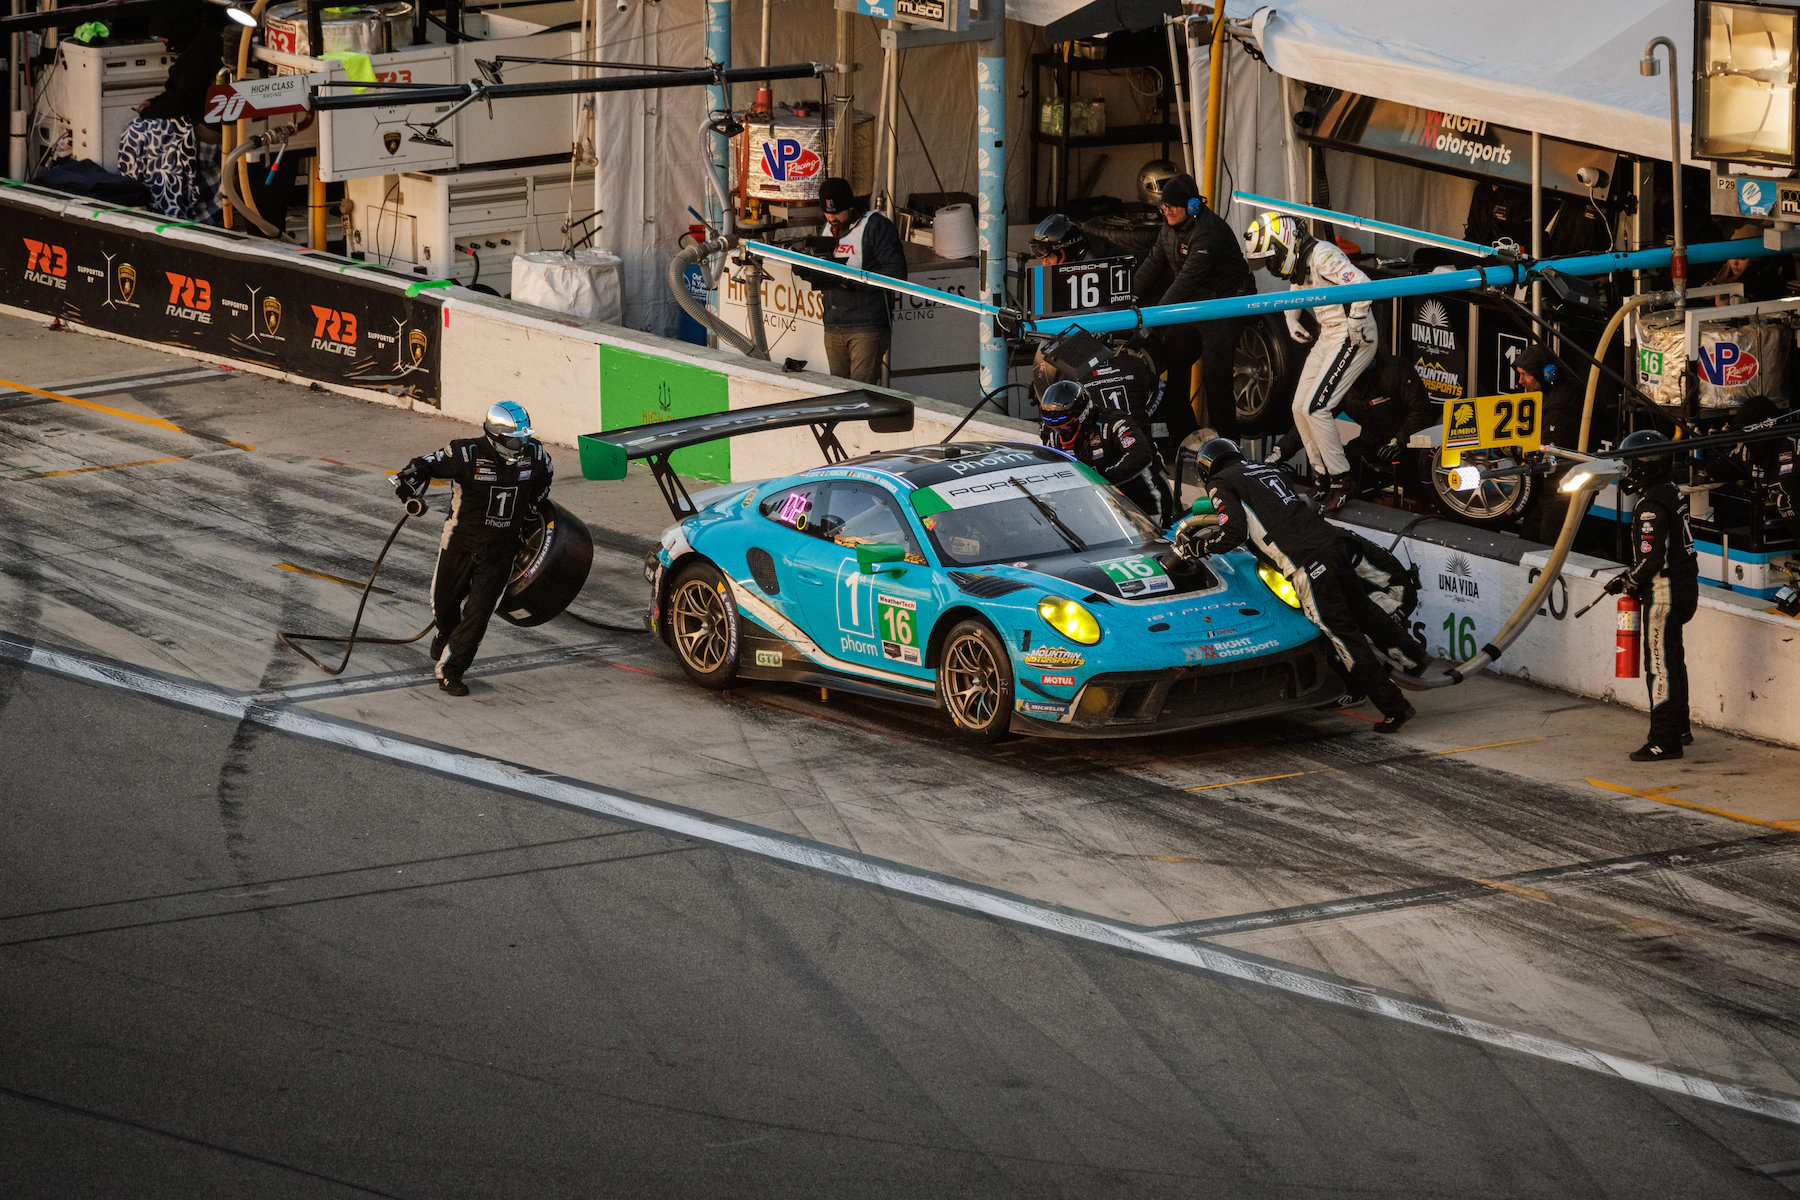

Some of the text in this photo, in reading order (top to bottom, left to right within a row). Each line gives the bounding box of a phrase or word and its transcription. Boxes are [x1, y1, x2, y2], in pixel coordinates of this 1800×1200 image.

[268, 30, 290, 53] 63
[250, 80, 295, 94] HIGH CLASS
[204, 93, 246, 124] 20
[1419, 126, 1512, 166] Motorsports
[762, 138, 801, 182] VP
[1725, 180, 1735, 190] 29
[1750, 206, 1769, 216] FPL
[23, 237, 68, 278] TR3
[1059, 263, 1108, 273] PORSCHE
[24, 269, 67, 290] RACING
[77, 265, 104, 278] SUPPORTED
[165, 271, 212, 311] TR3
[1066, 272, 1100, 309] 16
[1110, 294, 1131, 305] phorm
[1273, 295, 1327, 307] PHORM
[166, 304, 212, 324] RACING
[221, 298, 249, 312] SUPPORTED
[231, 309, 239, 317] BY
[310, 304, 357, 345] TR3
[763, 314, 797, 331] ACING
[367, 331, 396, 344] SUPPORTED
[377, 341, 386, 349] BY
[1411, 322, 1456, 350] UNA VIDA
[311, 337, 357, 357] RACING
[1642, 352, 1660, 374] 16
[1699, 342, 1740, 386] VP
[1494, 398, 1537, 440] 29
[1450, 427, 1477, 437] JUMBO
[948, 449, 1034, 476] phorm
[949, 470, 1076, 498] PORSCHE
[1108, 560, 1154, 581] 16
[1438, 573, 1480, 599] UNA VIDA
[879, 596, 916, 609] WeatherTech
[724, 601, 738, 657] MICHELIN
[884, 606, 912, 645] 16
[840, 634, 879, 657] phorm
[1199, 637, 1252, 651] WRIGHT
[1443, 612, 1477, 663] 16
[757, 653, 781, 665] GTD
[1031, 649, 1081, 659] MOUNTAIN
[1204, 639, 1280, 660] Motorsports
[1043, 676, 1073, 685] MOTUL
[1031, 704, 1065, 712] MICHELIN
